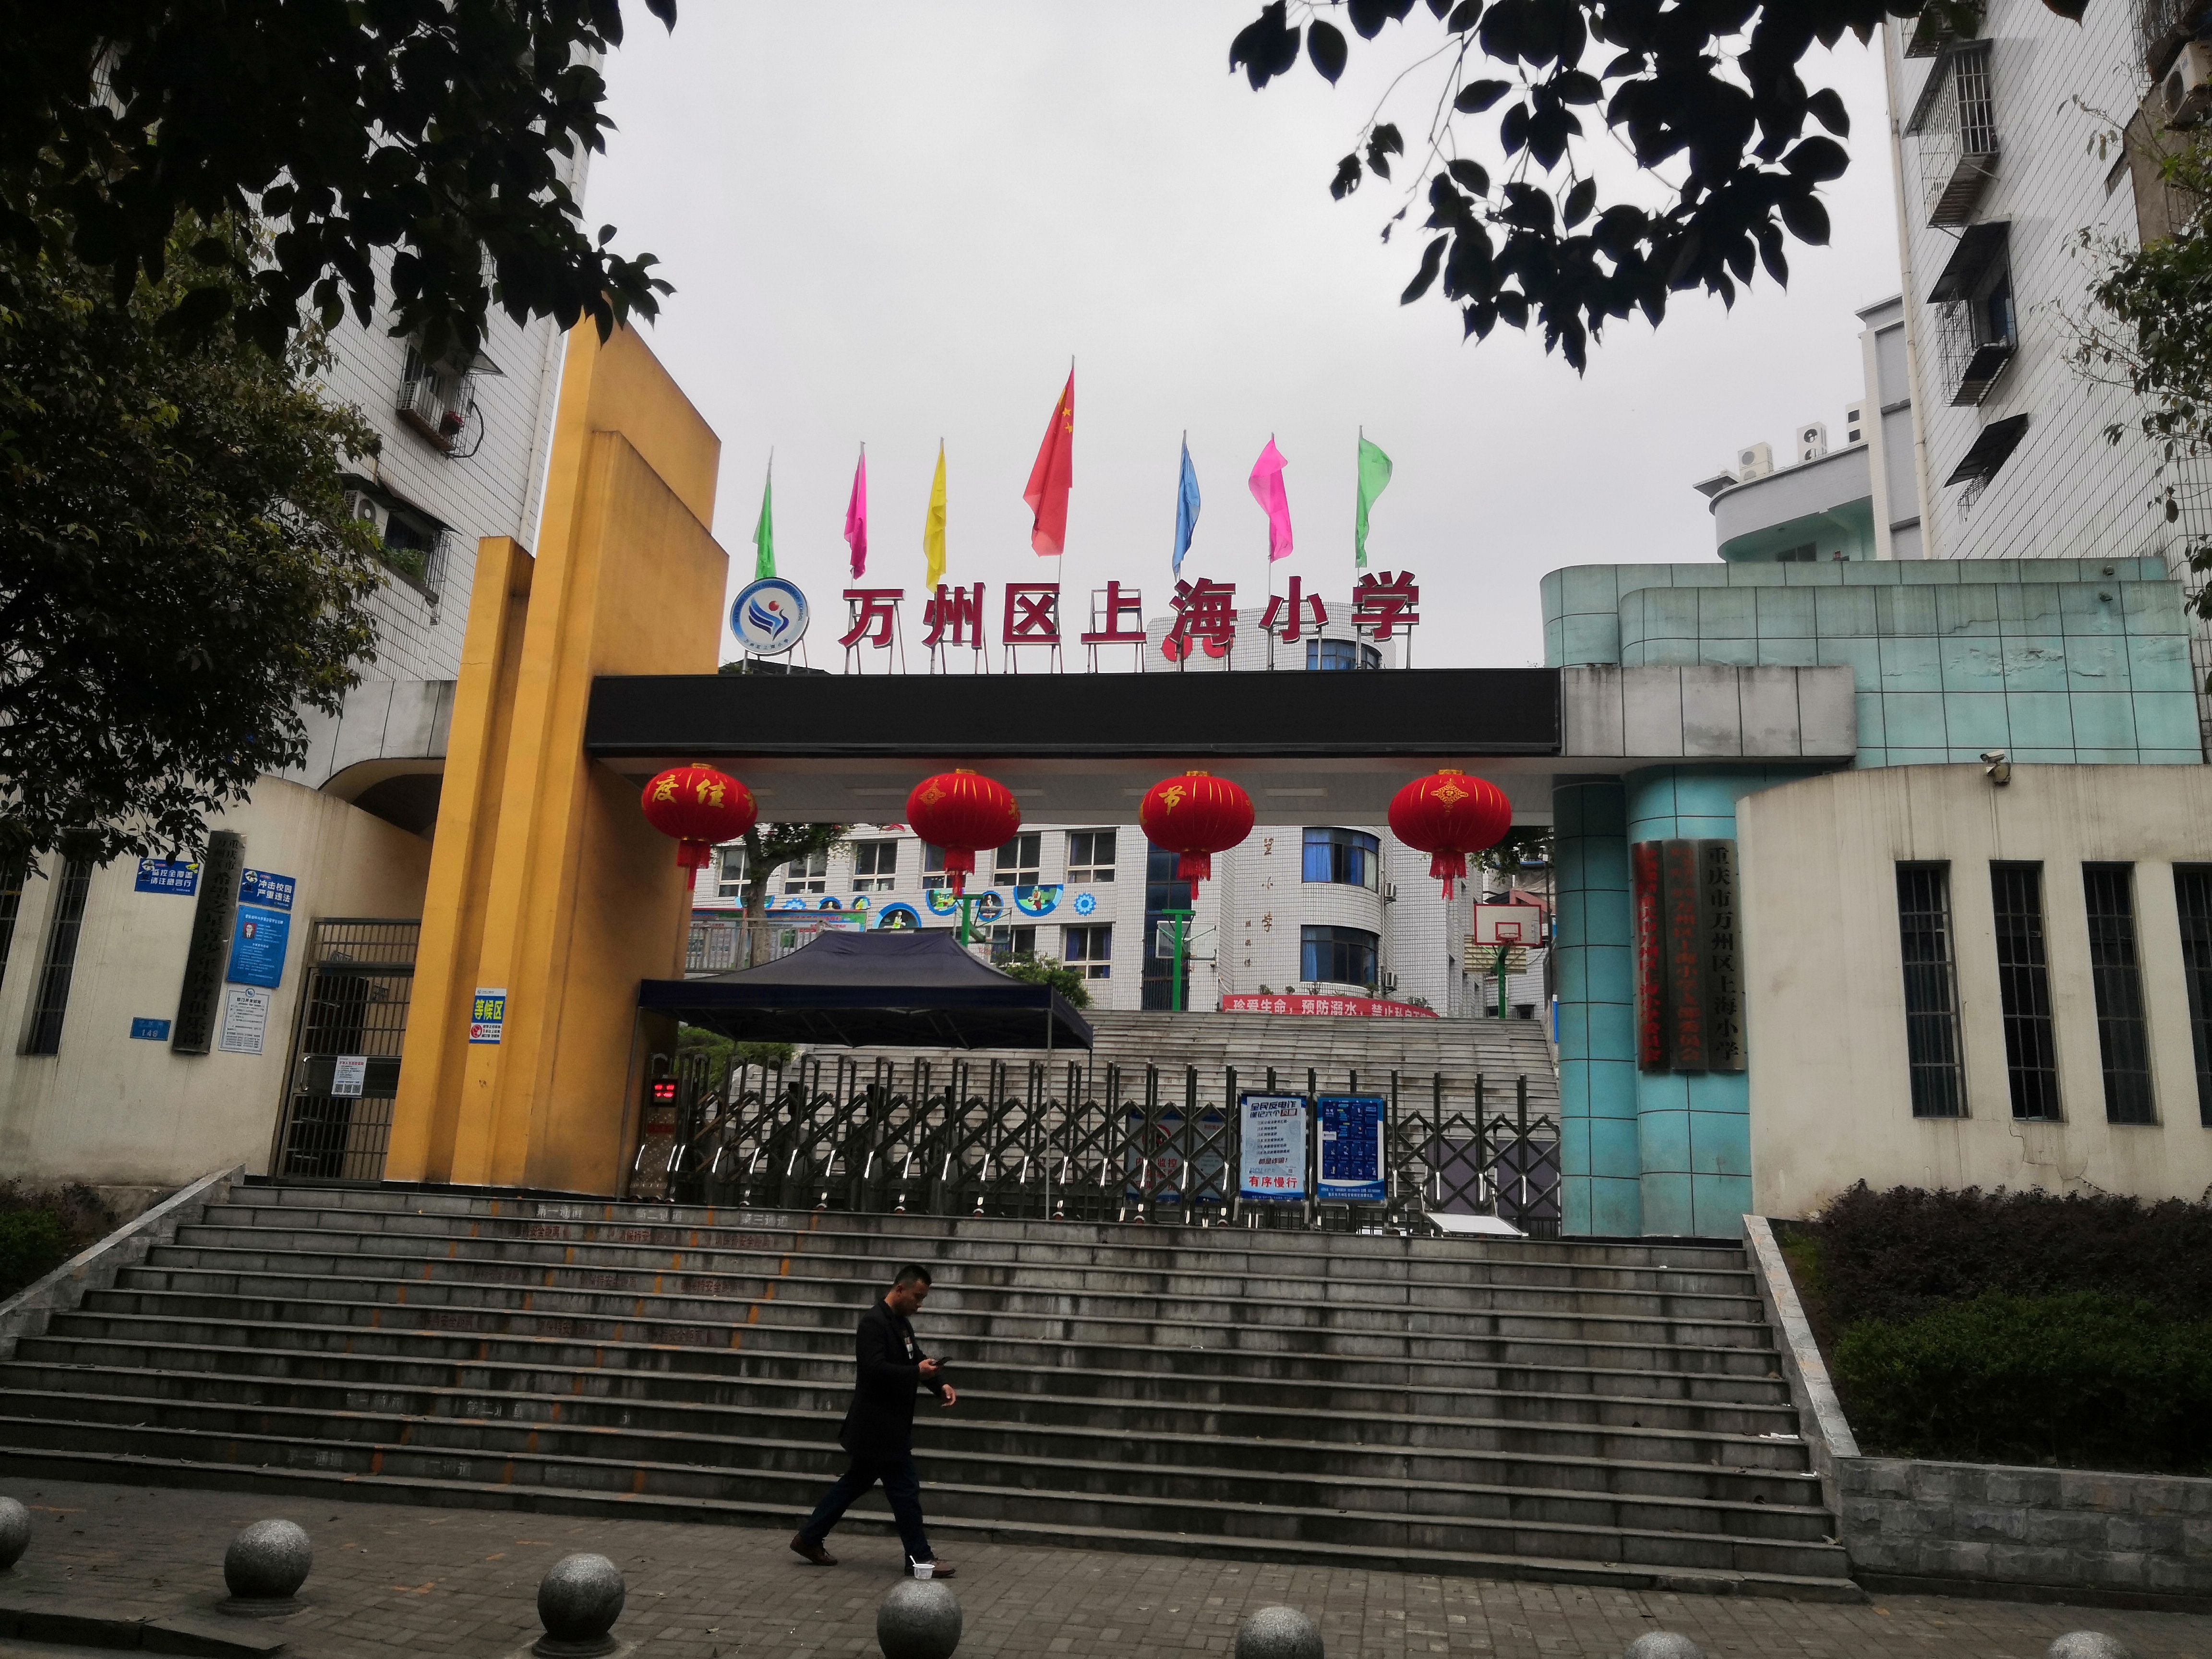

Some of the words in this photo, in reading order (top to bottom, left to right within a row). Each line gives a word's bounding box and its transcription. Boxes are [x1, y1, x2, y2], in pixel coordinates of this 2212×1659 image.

[838, 570, 1420, 649] 万州区上海小学
[258, 879, 293, 894] 冲击校园
[256, 889, 291, 903] 严重违法
[1706, 846, 1739, 1061] 重庆市万州区上海小学
[474, 999, 504, 1021] 等候区
[1249, 1176, 1298, 1189] 有序慢行
